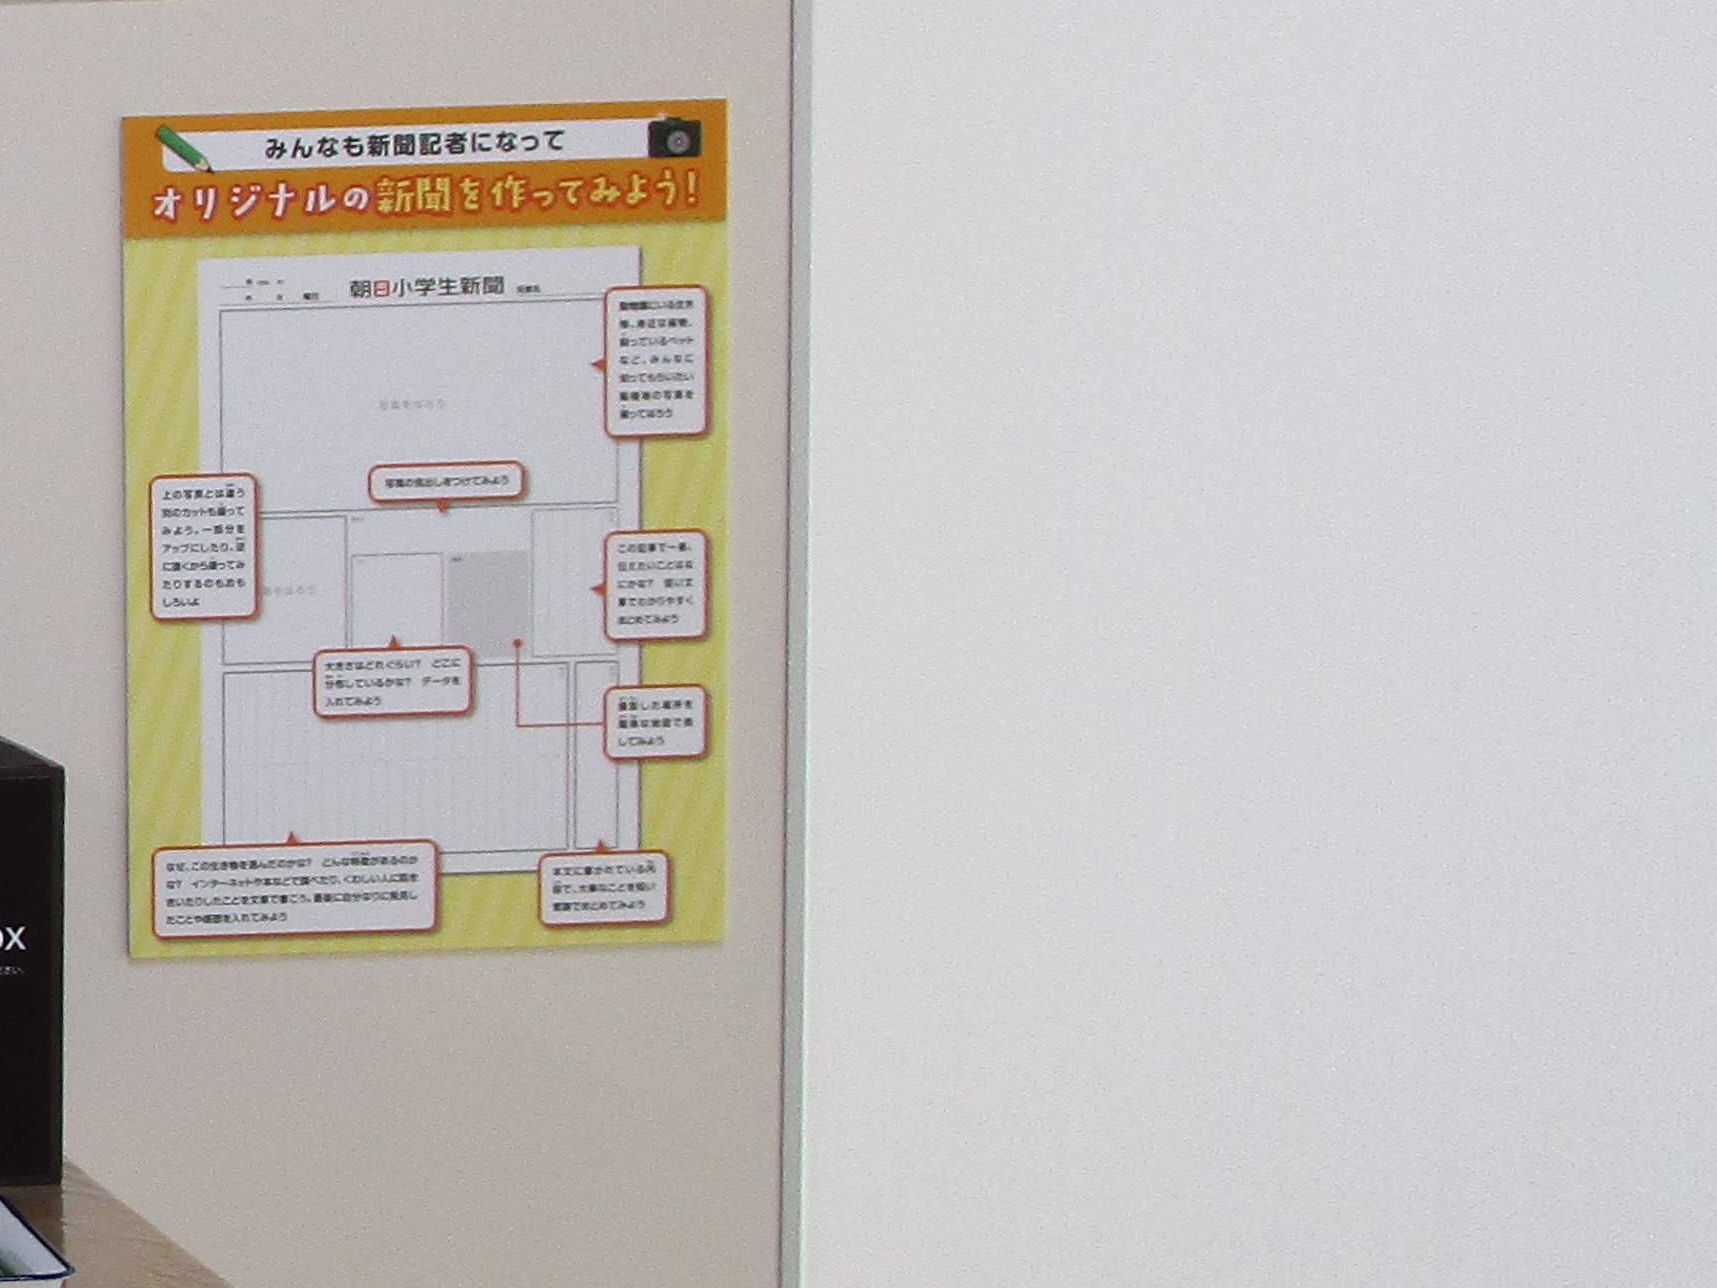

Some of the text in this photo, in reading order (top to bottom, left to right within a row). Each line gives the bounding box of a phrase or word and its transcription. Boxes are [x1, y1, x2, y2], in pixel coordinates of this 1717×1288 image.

[265, 129, 565, 160] みんなも新聞記者になって
[153, 170, 698, 220] オリジナルの新聞を作ってみよう！
[349, 275, 505, 299] 朝日小学生新聞
